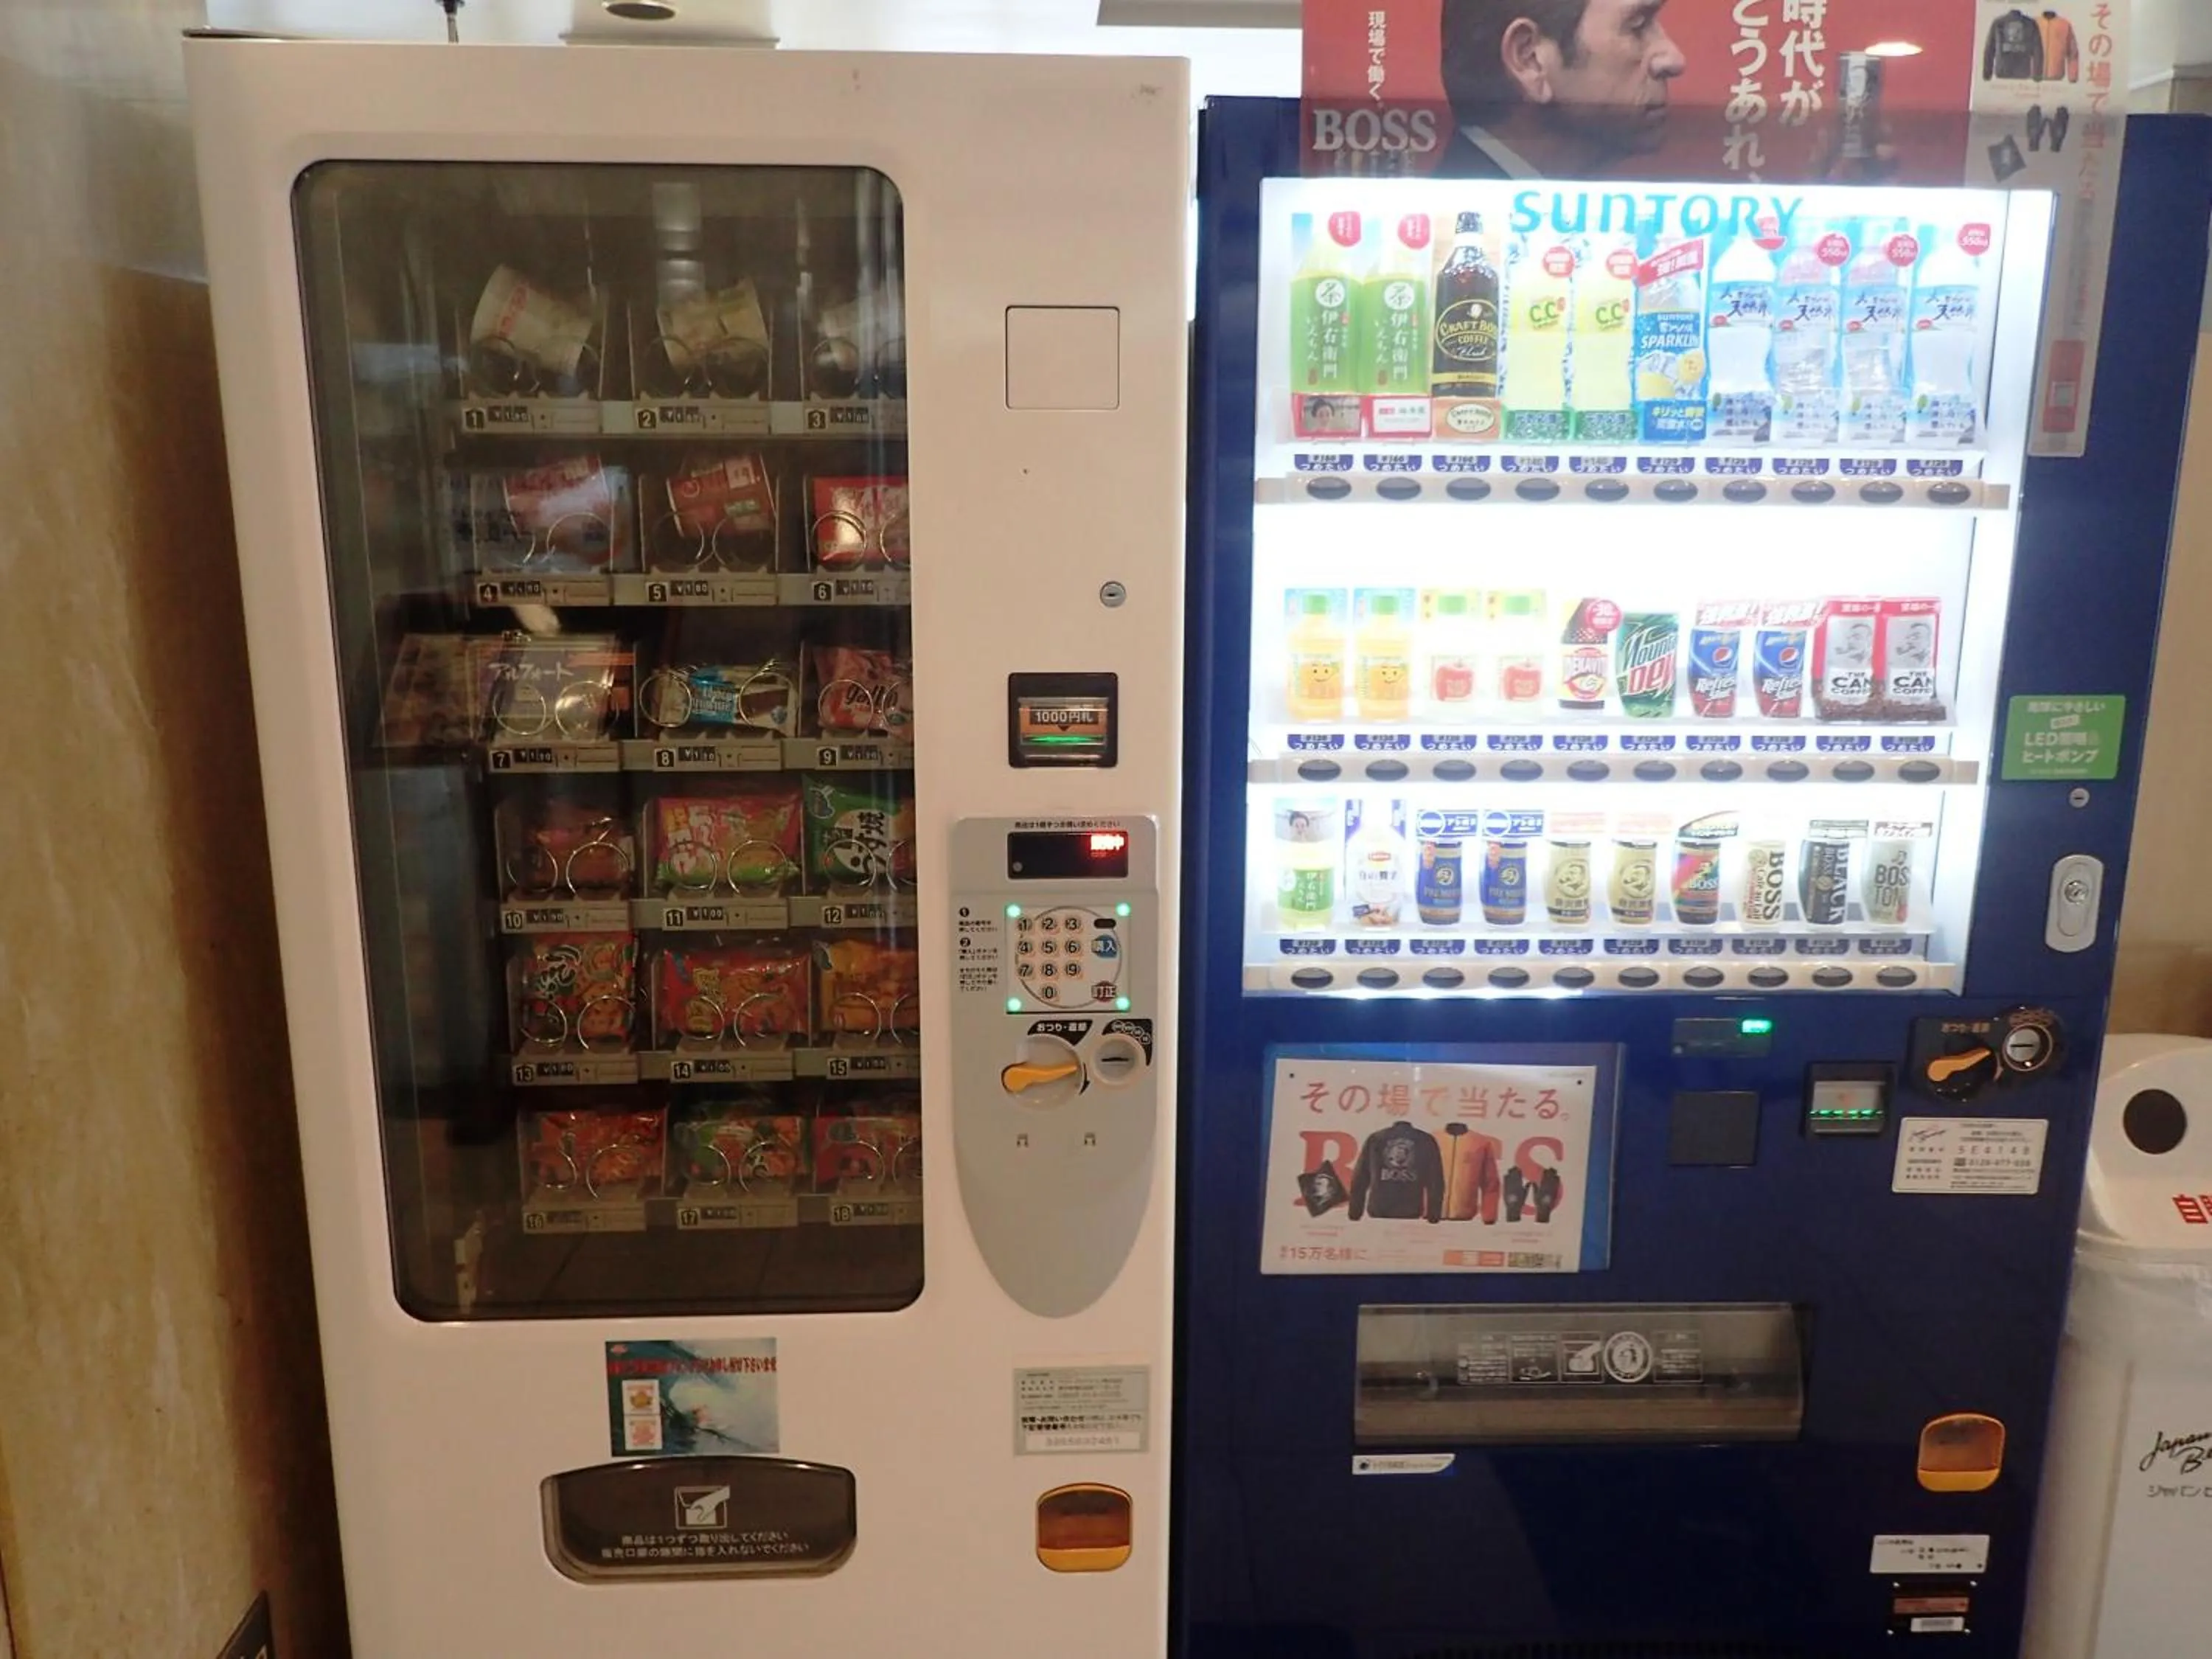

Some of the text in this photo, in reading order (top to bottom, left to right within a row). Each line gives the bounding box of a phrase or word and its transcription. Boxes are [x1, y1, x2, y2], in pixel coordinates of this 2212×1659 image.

[1312, 108, 1436, 153] BOSS
[1301, 462, 1349, 471] つめたい
[1369, 463, 1417, 471] つめたい
[1439, 464, 1486, 472] つめたい
[1711, 465, 1758, 474] つめたい
[489, 661, 574, 682] アルフォート
[1035, 711, 1094, 723] 1000円札
[1763, 850, 1785, 921] BOSS
[1300, 1081, 1571, 1121] その場で当たる。
